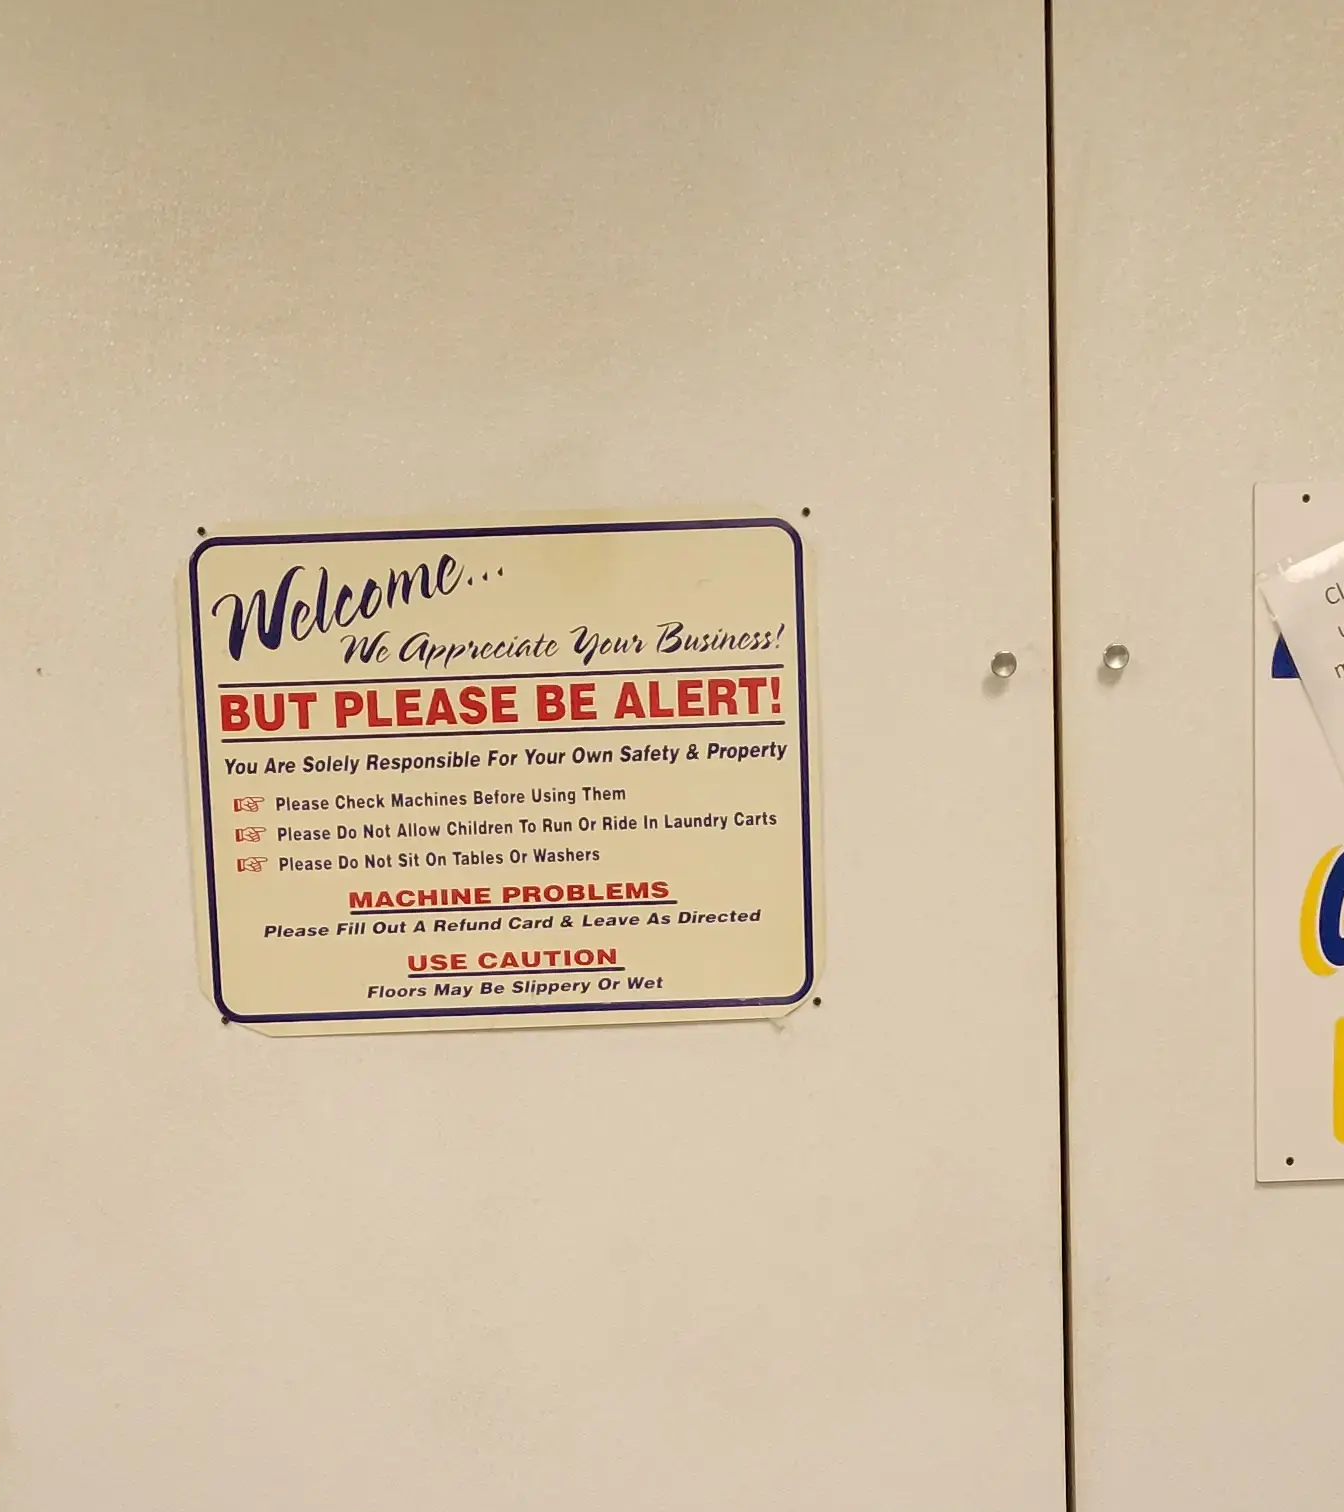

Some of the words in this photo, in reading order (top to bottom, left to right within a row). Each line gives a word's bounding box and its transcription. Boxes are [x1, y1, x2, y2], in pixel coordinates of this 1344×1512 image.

[211, 553, 503, 662] Welcome...
[340, 630, 391, 664] We
[398, 631, 559, 670] Appreciate
[569, 625, 648, 666] Your
[656, 621, 786, 653] Business!
[220, 692, 317, 732] BUT
[334, 685, 519, 728] PLEASE
[536, 683, 598, 722] BE
[614, 676, 781, 719] ALERT!
[224, 758, 258, 775] You
[264, 757, 297, 773] Are
[302, 755, 360, 775] Solely
[366, 751, 481, 773] Responsible
[487, 749, 518, 767] For
[524, 748, 566, 766] Your
[572, 746, 613, 764] Own
[619, 744, 680, 764] Safety
[685, 743, 700, 760] &
[706, 741, 788, 762] Property
[275, 797, 329, 811] Please
[335, 794, 386, 810] Check
[391, 791, 468, 808] Machines
[473, 789, 525, 805] Before
[531, 788, 576, 805] Using
[582, 786, 626, 801] Them
[277, 827, 331, 842] Please
[337, 825, 357, 840] Do
[363, 824, 391, 839] Not
[397, 822, 441, 838] Allow
[446, 819, 513, 836] Children
[519, 819, 537, 833] To
[543, 818, 573, 833] Run
[578, 816, 597, 832] Or
[602, 815, 638, 831] Ride
[643, 815, 658, 829] In
[664, 813, 728, 830] Laundry
[734, 811, 777, 827] Carts
[279, 857, 333, 872] Please
[338, 855, 359, 870] Do
[364, 853, 393, 869] Not
[398, 852, 420, 868] Sit
[425, 851, 447, 866] On
[452, 850, 504, 866] Tables
[509, 849, 528, 864] Or
[533, 848, 600, 864] Washers
[348, 887, 492, 909] MACHINE
[502, 881, 670, 904] PROBLEMS
[263, 925, 330, 938] Please
[336, 922, 366, 935] Fill
[372, 921, 407, 934] Out
[412, 920, 426, 933] A
[433, 918, 502, 932] Refund
[508, 916, 554, 930] Card
[560, 915, 574, 928] &
[582, 914, 640, 927] Leave
[646, 912, 671, 925] As
[677, 909, 761, 924] Directed
[407, 954, 468, 972] USE
[477, 948, 617, 971] CAUTION
[367, 985, 427, 999] Floors
[433, 983, 473, 998] May
[480, 982, 505, 994] Be
[511, 979, 591, 995] Slippery
[598, 977, 621, 991] Or
[627, 976, 664, 990] Wet
